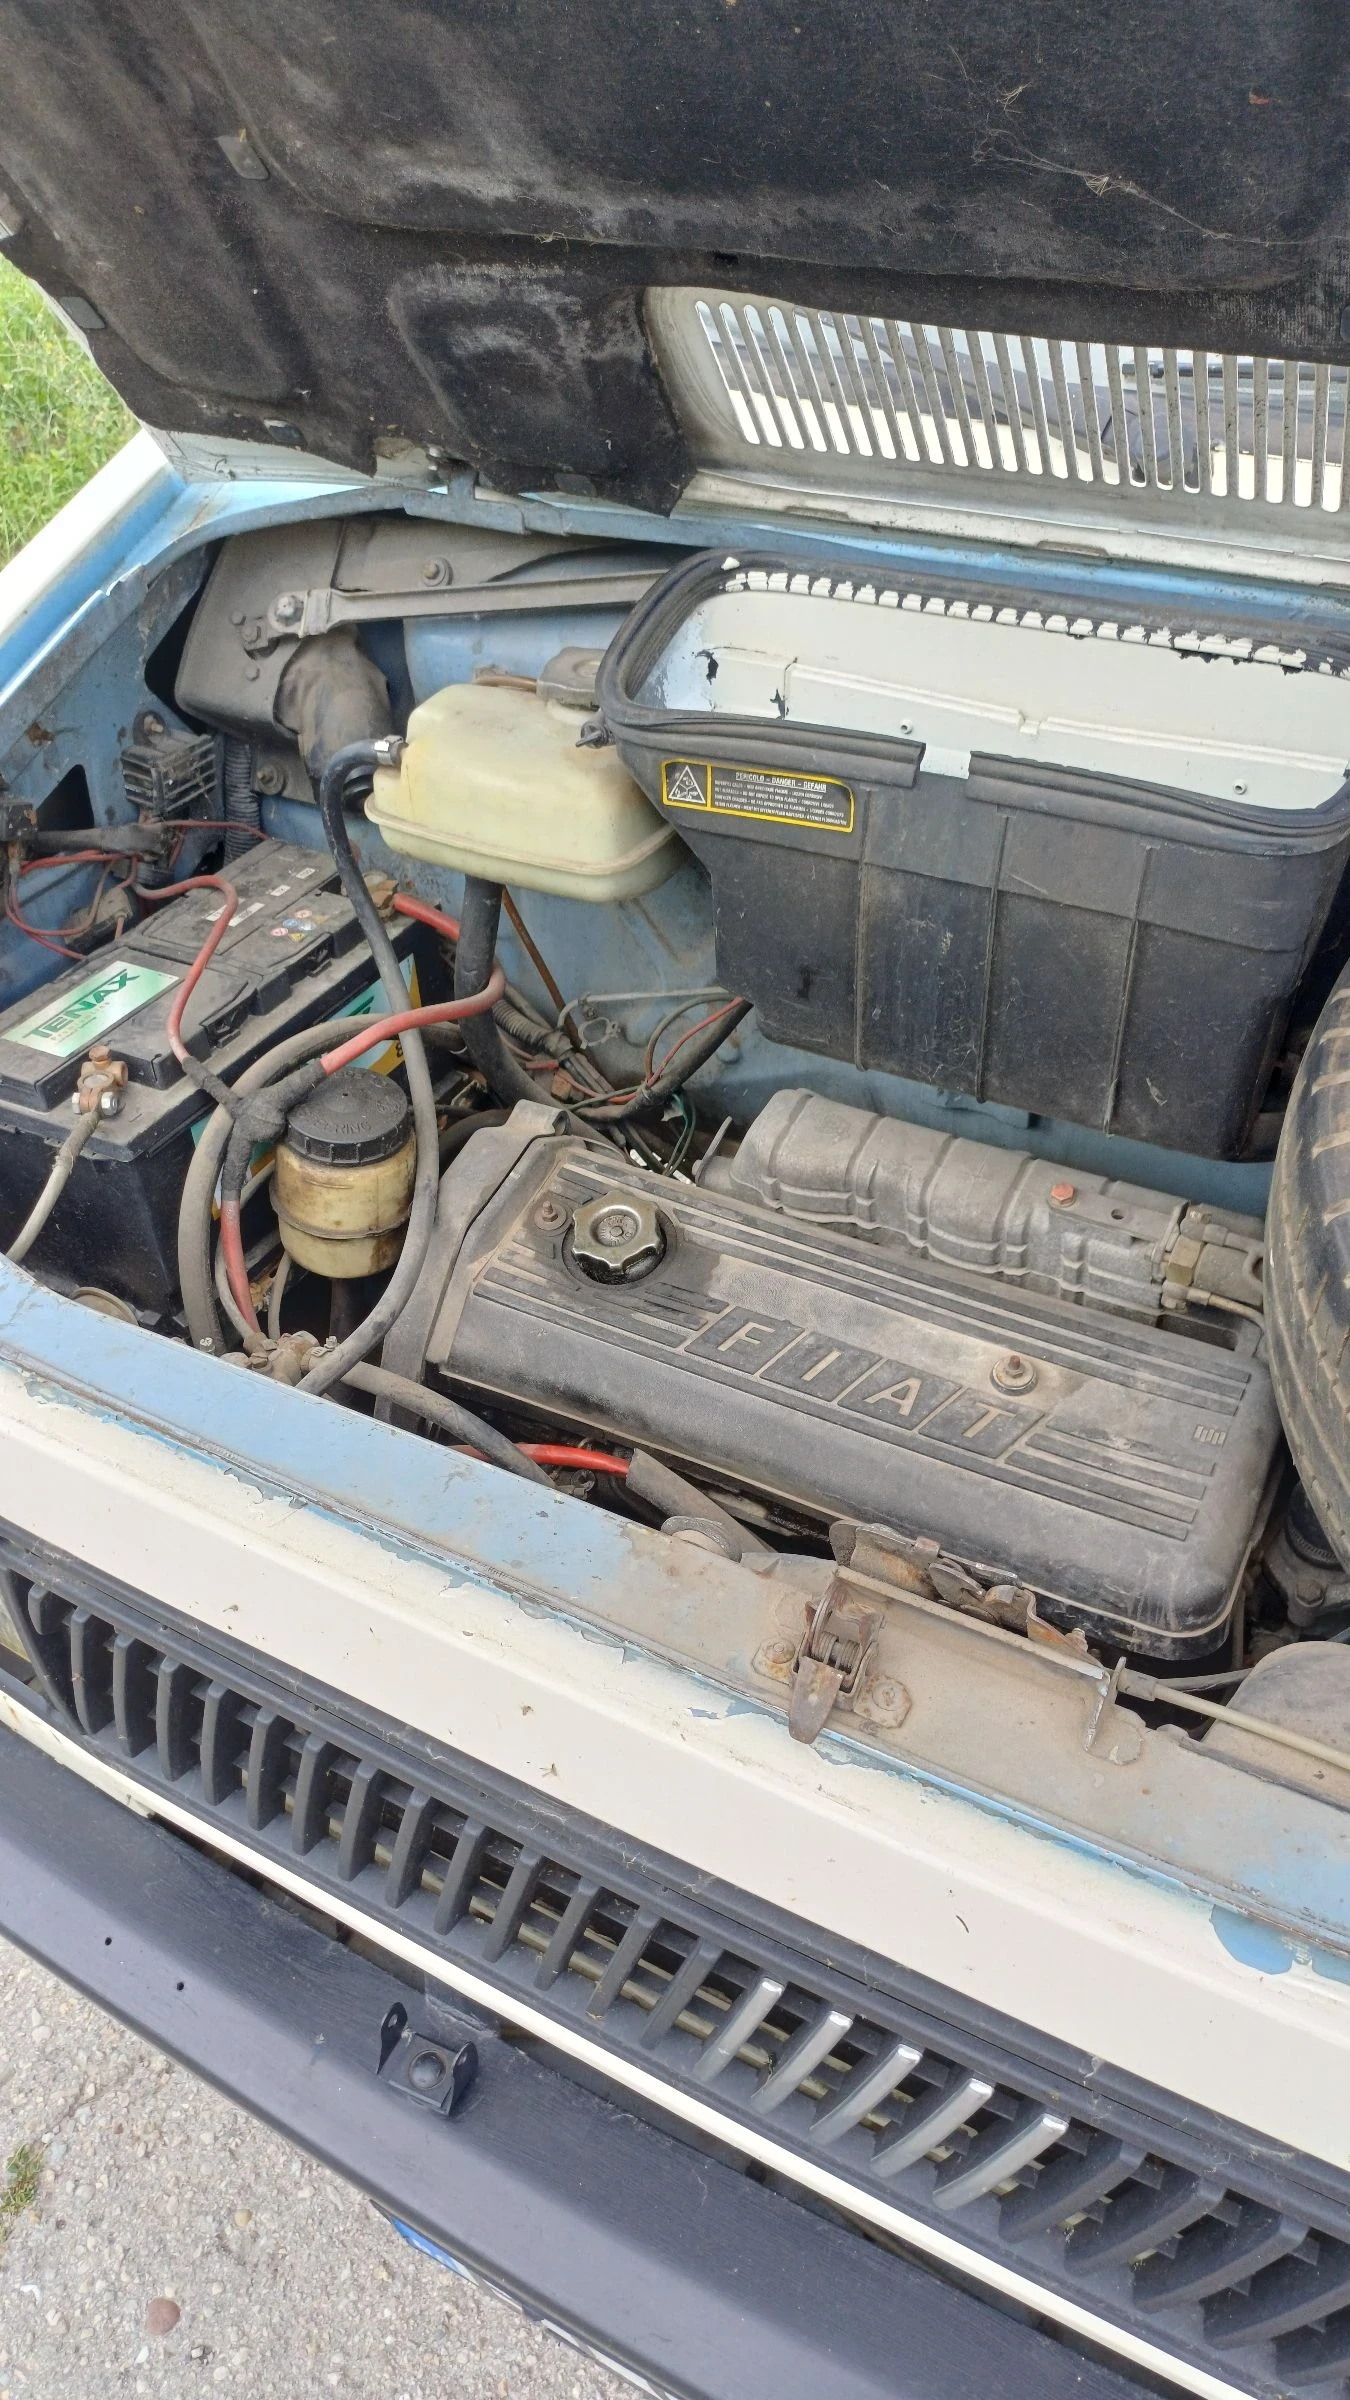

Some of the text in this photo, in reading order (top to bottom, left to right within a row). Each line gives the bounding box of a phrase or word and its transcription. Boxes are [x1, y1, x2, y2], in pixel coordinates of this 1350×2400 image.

[736, 772, 765, 783] PERICOLO
[771, 776, 796, 787] DANGER
[22, 969, 140, 1039] TENAX
[717, 1320, 1015, 1439] FIAT
